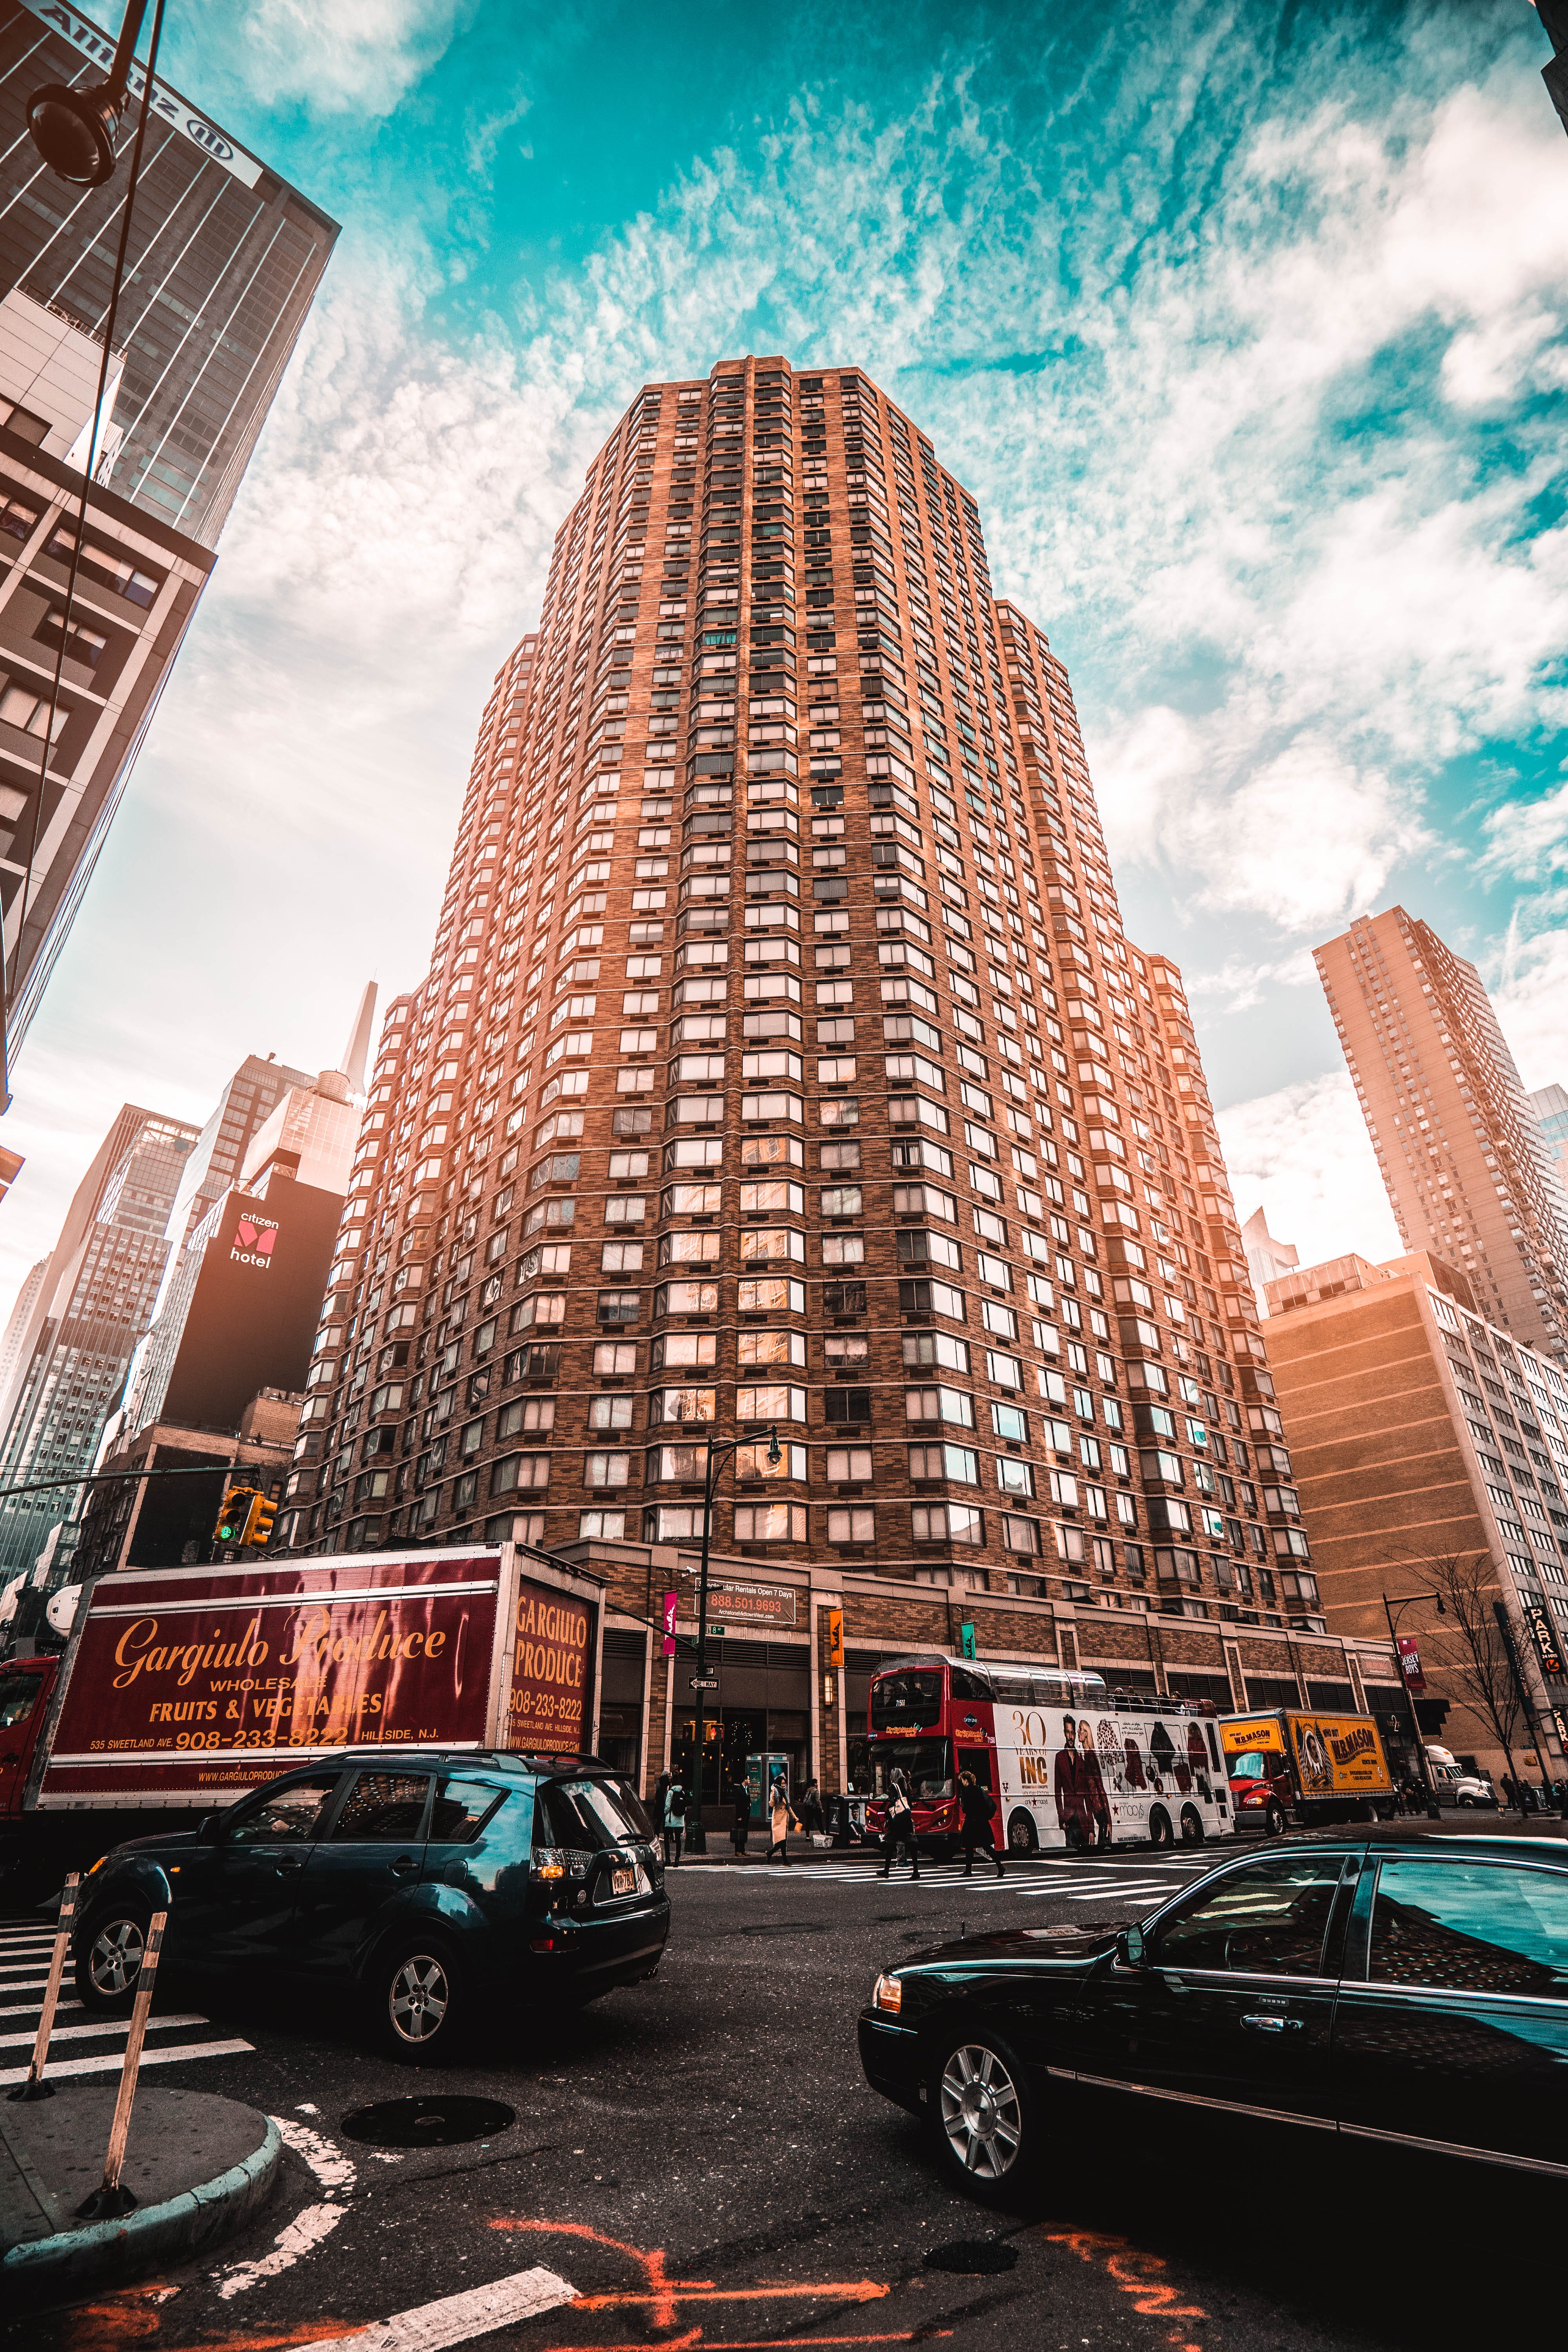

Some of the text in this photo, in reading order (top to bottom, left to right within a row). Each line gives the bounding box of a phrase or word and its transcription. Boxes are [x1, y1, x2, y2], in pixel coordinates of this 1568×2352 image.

[39, 5, 179, 119] Allinz
[241, 1213, 279, 1229] citizen
[230, 1247, 270, 1269] hotel
[735, 1585, 756, 1594] Rentals
[758, 1588, 772, 1596] Open
[779, 1590, 792, 1599] Days
[711, 1594, 781, 1612] 888.501.9693
[516, 1596, 587, 1648] GARGIULO
[718, 1609, 774, 1619] ArchstoneMidtownWest.com
[1530, 1608, 1554, 1654] PARK
[113, 1605, 446, 1688] Gargiulo Produce
[515, 1639, 582, 1688] PRODUCE
[1402, 1653, 1419, 1666] JERSEY
[1405, 1662, 1419, 1674] BOYS
[210, 1676, 327, 1692] WHOLESALE
[149, 1693, 382, 1722] FRUITS & VEGETABLES
[509, 1688, 582, 1721] 908-233-8222
[517, 1719, 544, 1730] SWEETLAND
[1013, 1711, 1046, 1746] 30
[90, 1727, 439, 1751] 535 SWEETLAND AVE. 908-233-8222 HILLSIDE, N.J.
[199, 1769, 287, 1782] WWW.GARGIULOPRODUC
[1120, 1803, 1144, 1819] macy's
